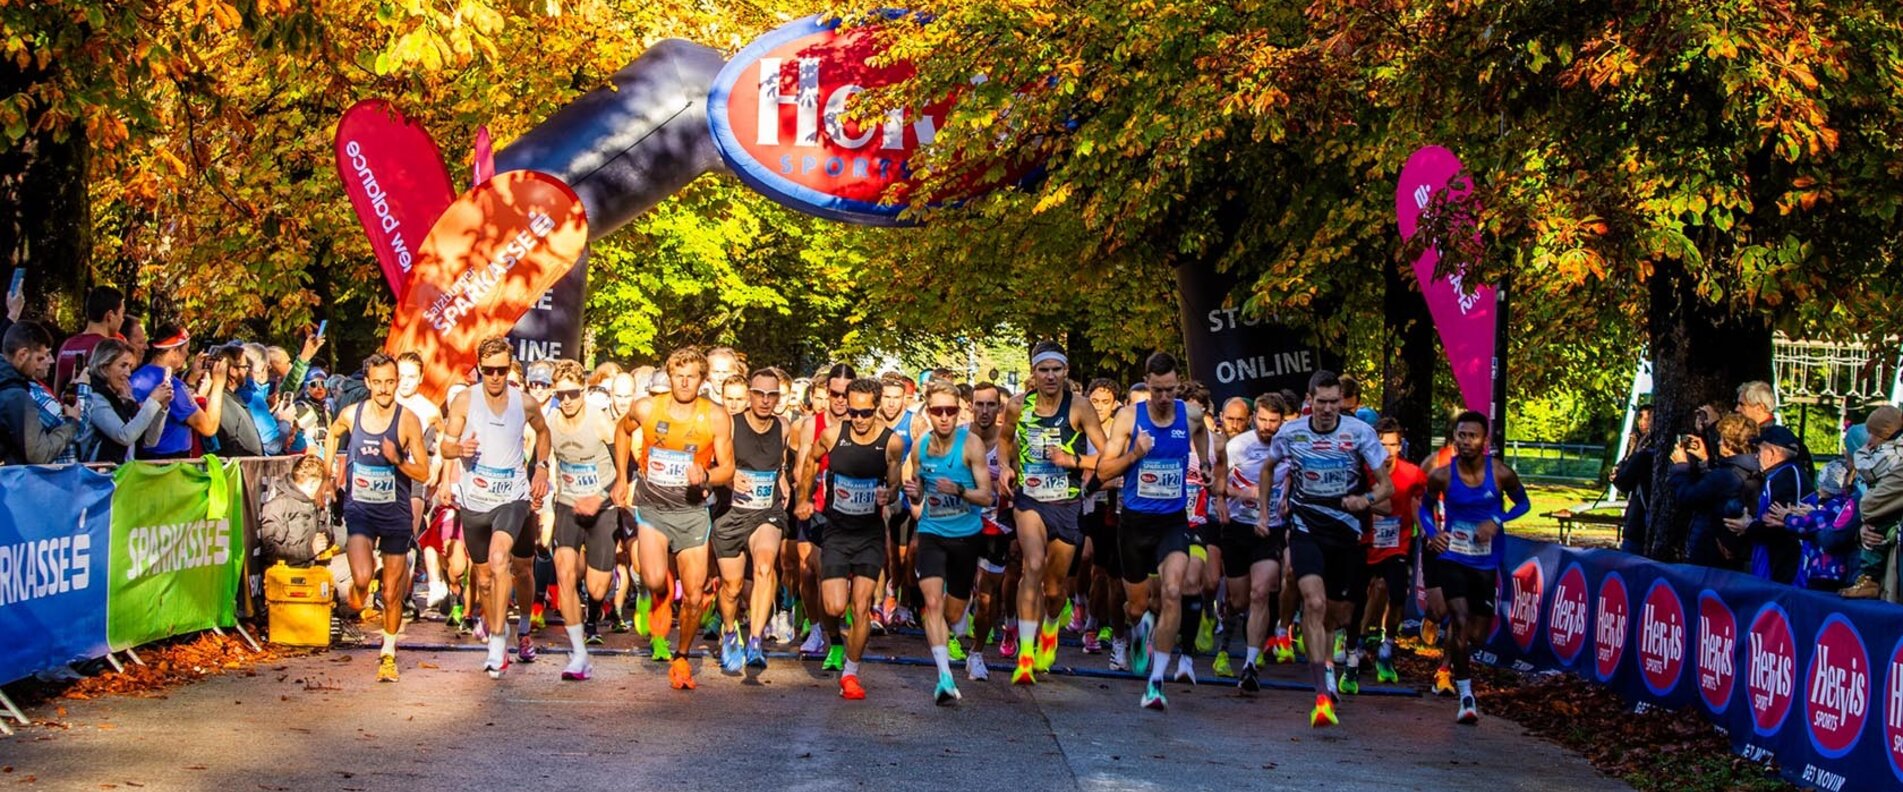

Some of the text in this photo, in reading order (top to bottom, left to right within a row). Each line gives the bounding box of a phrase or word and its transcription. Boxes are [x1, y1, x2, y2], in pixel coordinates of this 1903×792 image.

[422, 266, 475, 322] Salzburger
[433, 230, 538, 337] SPARKASSE
[1216, 351, 1312, 384] ONLINE
[127, 518, 214, 580] SPARKASSE
[1551, 585, 1586, 642] Hervis
[1596, 596, 1626, 657] Hervis
[1641, 603, 1682, 669] Hervis
[1700, 615, 1733, 686] Hervis
[1750, 632, 1792, 707] Hervis
[1810, 643, 1865, 727] Hervis
[1814, 710, 1839, 732] SPORTS
